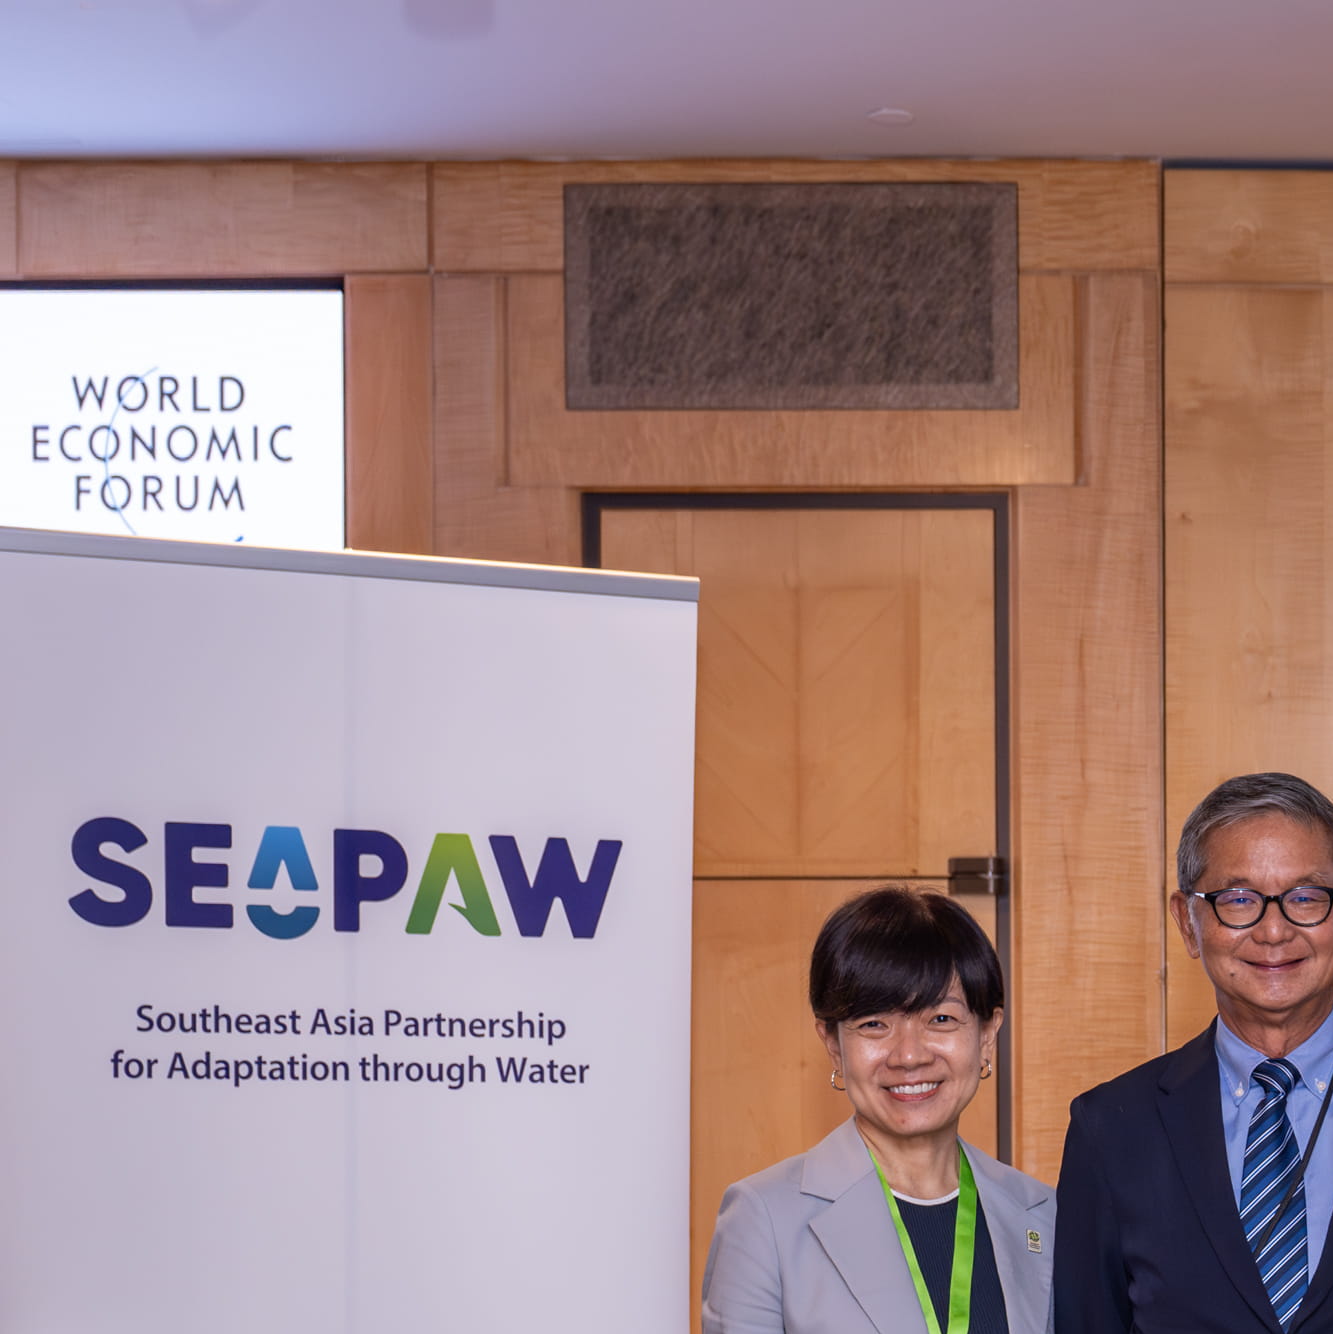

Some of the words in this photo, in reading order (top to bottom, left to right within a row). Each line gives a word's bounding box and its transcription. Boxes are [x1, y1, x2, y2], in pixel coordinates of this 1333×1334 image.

[72, 375, 245, 412] WORLD
[32, 425, 293, 462] ECONOMIC
[75, 475, 245, 512] FORUM
[68, 816, 622, 940] SEAPAW
[136, 1004, 301, 1035] Southeast
[310, 1008, 374, 1036] Asia
[384, 1009, 566, 1046] Partnership
[111, 1049, 159, 1079] for
[167, 1051, 350, 1088] Adaptation
[359, 1054, 486, 1090] through
[496, 1057, 590, 1084] Water
